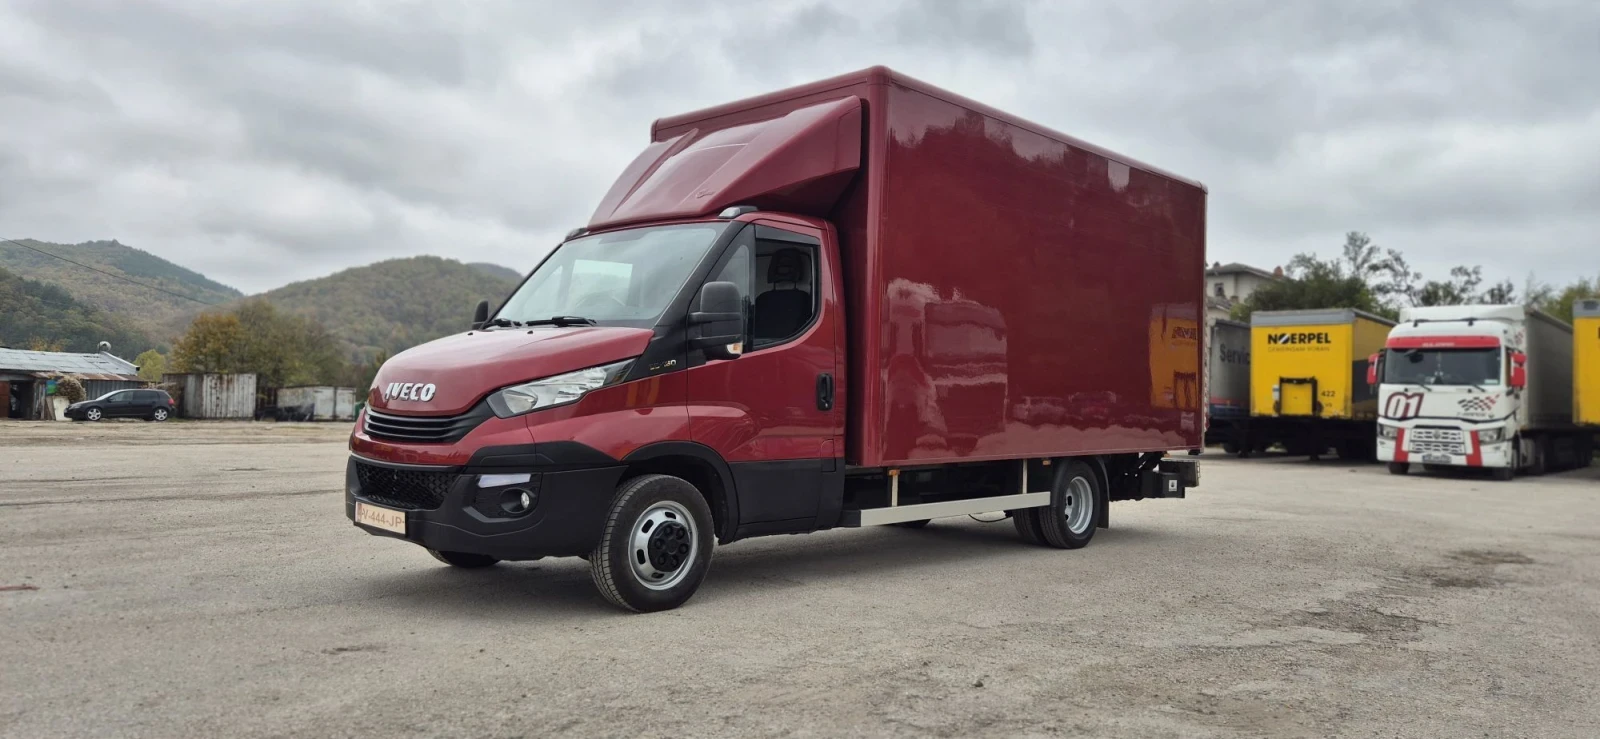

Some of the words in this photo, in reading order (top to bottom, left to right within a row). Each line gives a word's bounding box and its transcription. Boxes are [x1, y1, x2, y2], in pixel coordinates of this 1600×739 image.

[385, 382, 436, 402] IVECO
[1321, 390, 1336, 398] 422
[1384, 391, 1425, 420] 01
